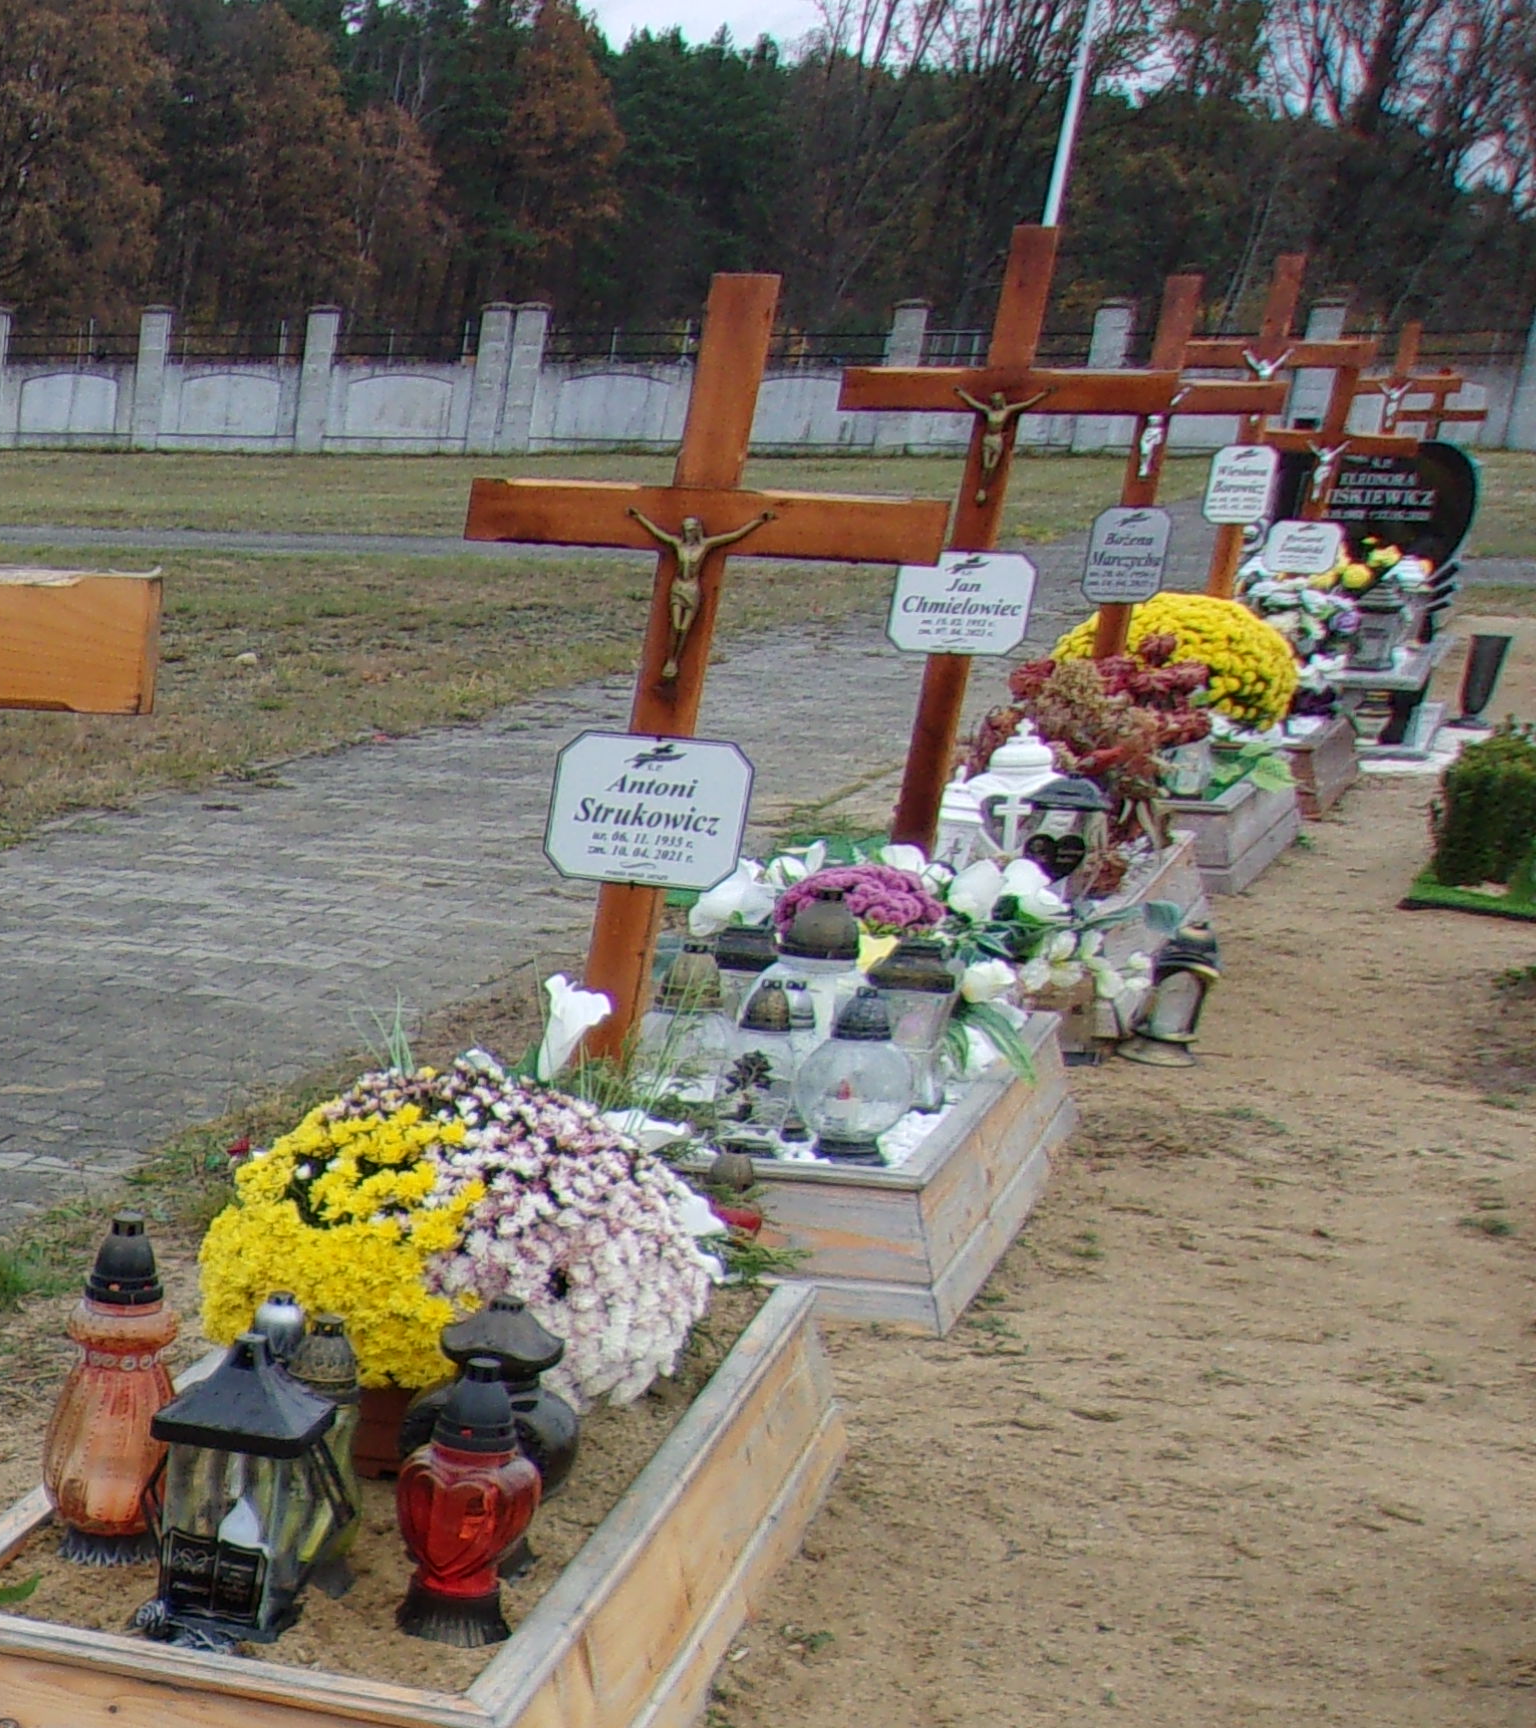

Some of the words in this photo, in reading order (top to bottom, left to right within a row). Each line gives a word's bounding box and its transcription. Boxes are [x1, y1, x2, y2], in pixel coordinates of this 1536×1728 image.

[945, 578, 981, 592] Jan
[902, 595, 1022, 617] Chmielowiec
[605, 773, 698, 798] Antoni
[573, 797, 721, 836] Strukowicz
[654, 849, 683, 861] 2021
